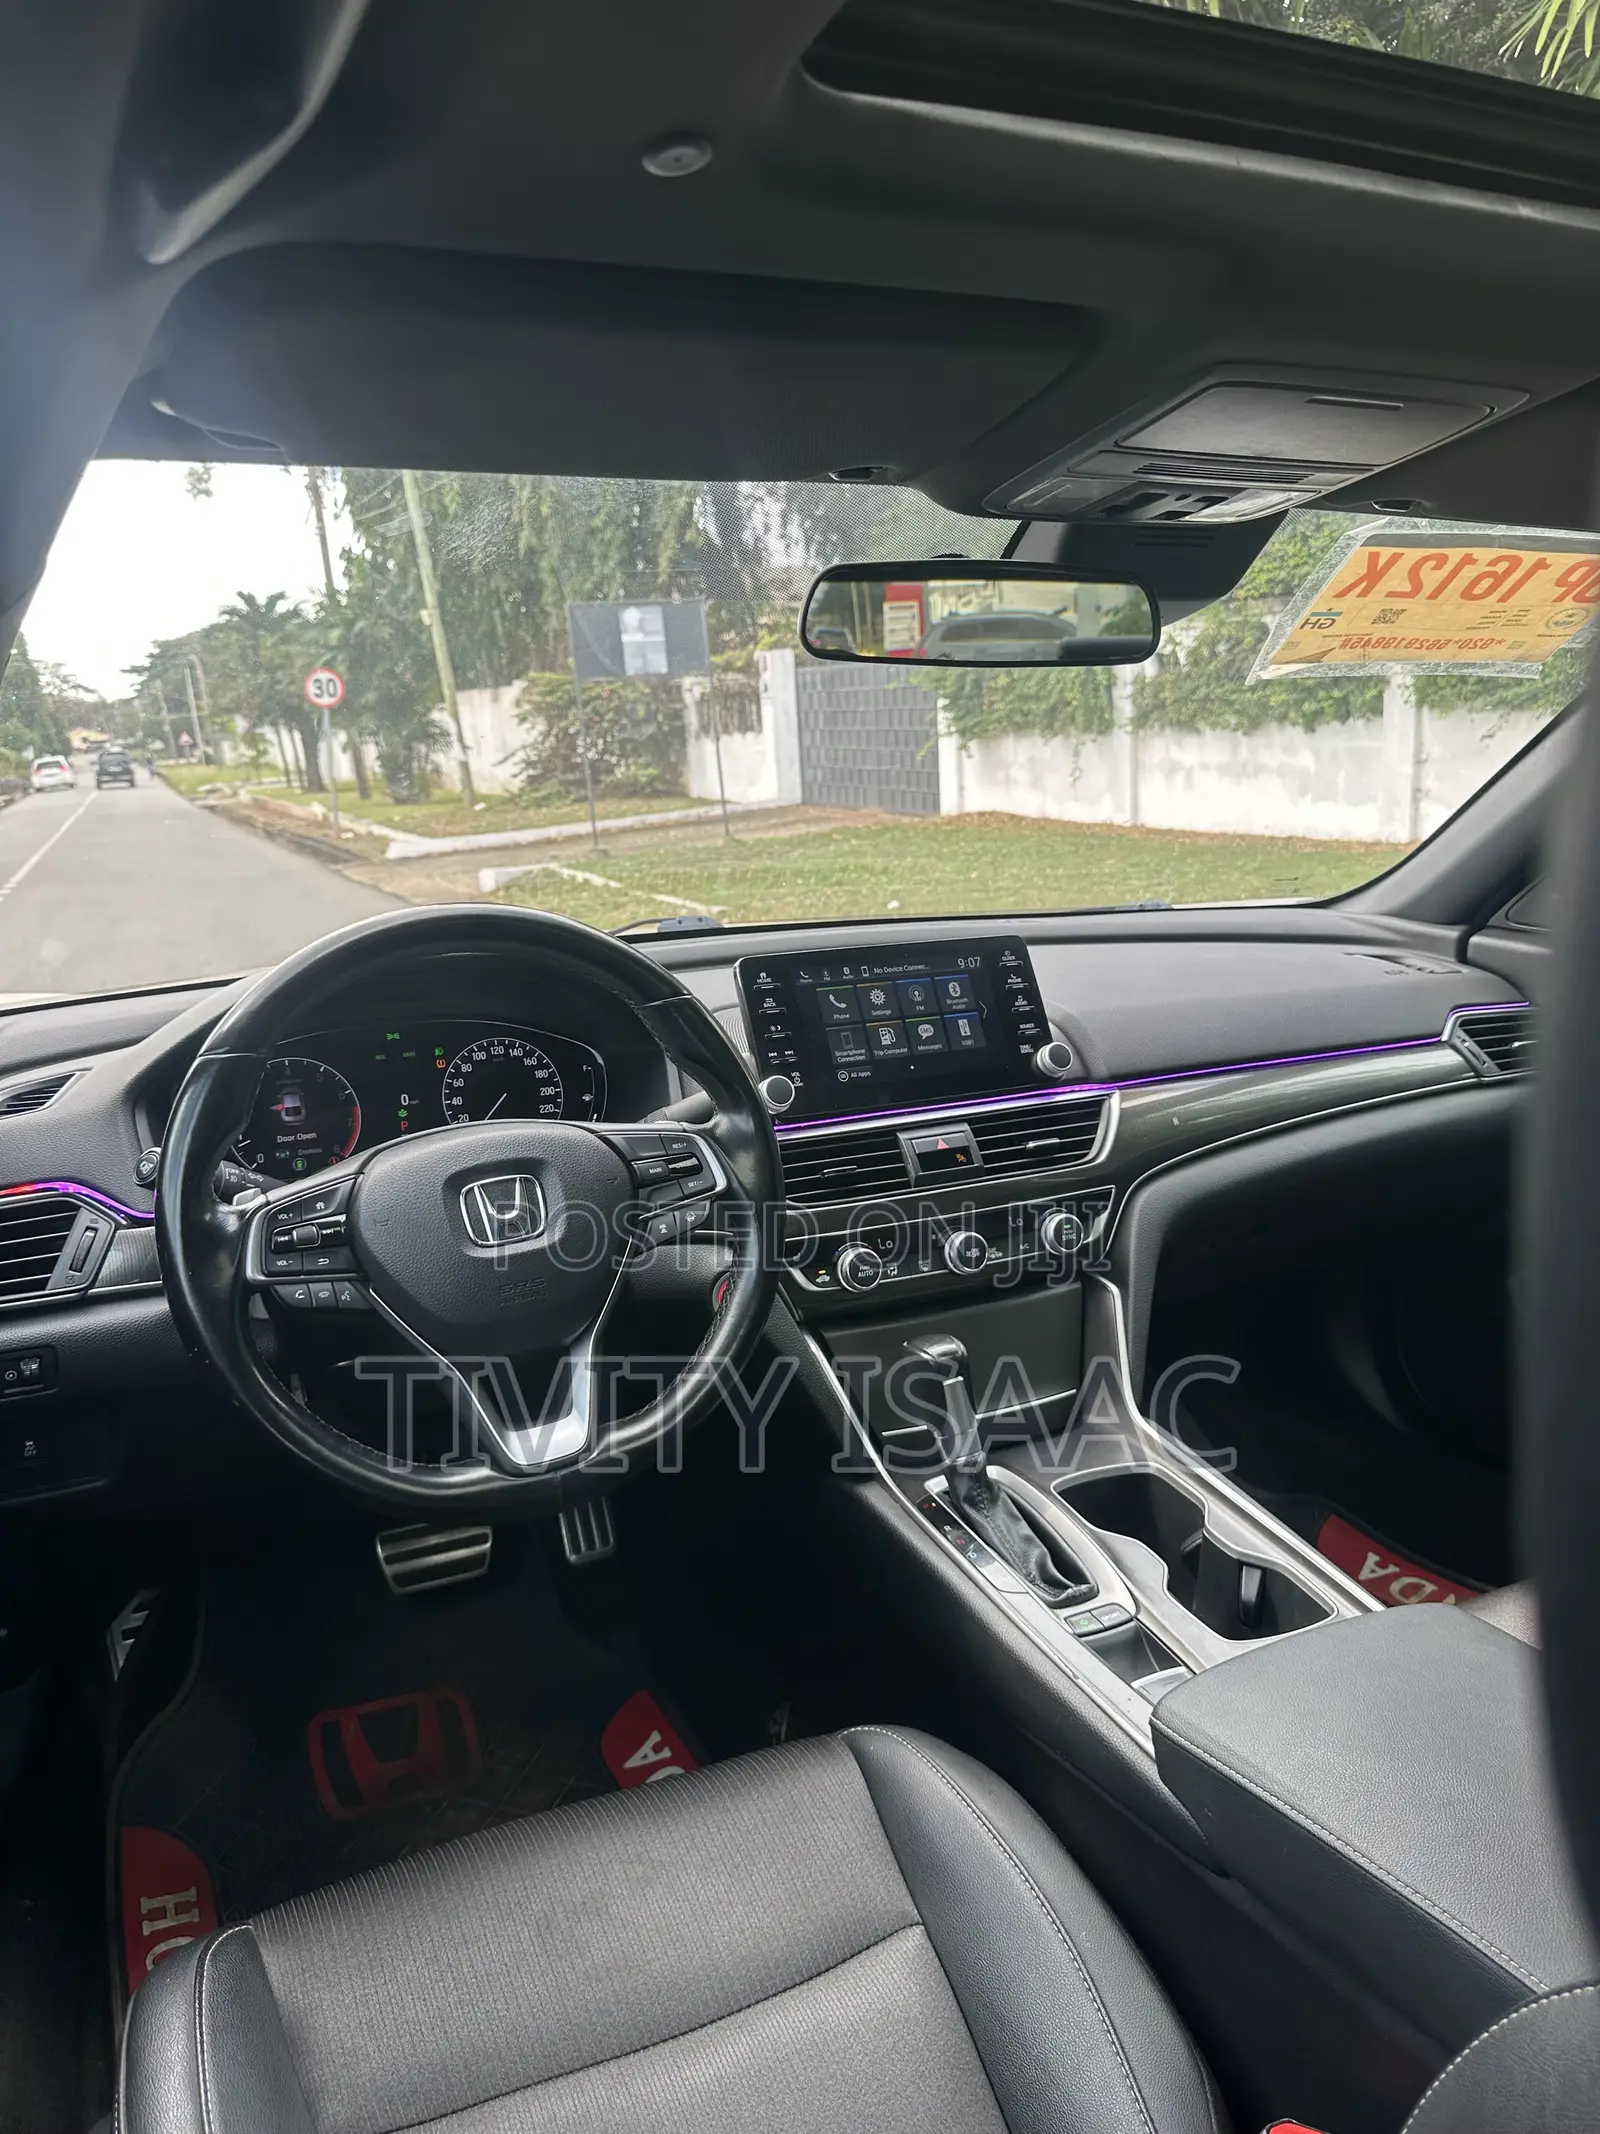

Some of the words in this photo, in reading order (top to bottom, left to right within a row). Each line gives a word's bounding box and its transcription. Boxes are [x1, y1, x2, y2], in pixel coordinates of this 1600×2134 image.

[312, 678, 338, 698] 30
[957, 956, 981, 969] 9:07
[874, 967, 883, 975] No
[883, 965, 903, 974] Device
[871, 1008, 892, 1017] Settings
[490, 1046, 505, 1055] 120
[508, 1047, 524, 1057] 140
[874, 1049, 884, 1057] Trip
[884, 1047, 908, 1056] Computer
[917, 1043, 943, 1051] Messages
[472, 1051, 487, 1061] 100
[834, 1048, 866, 1057] Smartphone
[523, 1056, 538, 1066] 160
[837, 1054, 866, 1063] Connection
[284, 1067, 292, 1076] 4
[460, 1063, 473, 1073] 80
[316, 1073, 324, 1082] 5
[534, 1069, 549, 1079] 180
[858, 1071, 871, 1079] Apps
[452, 1078, 464, 1088] 60
[540, 1086, 555, 1096] 200
[400, 1093, 409, 1106] 0
[451, 1096, 463, 1106] 40
[539, 1103, 555, 1114] 220
[457, 1113, 470, 1123] 20
[400, 1120, 409, 1131] P
[276, 1134, 295, 1143] Door
[296, 1132, 317, 1141] Open
[257, 1153, 265, 1164] 0
[1062, 1233, 1077, 1241] SYNC
[857, 1269, 874, 1278] AUTO
[1358, 1550, 1456, 1605] DA
